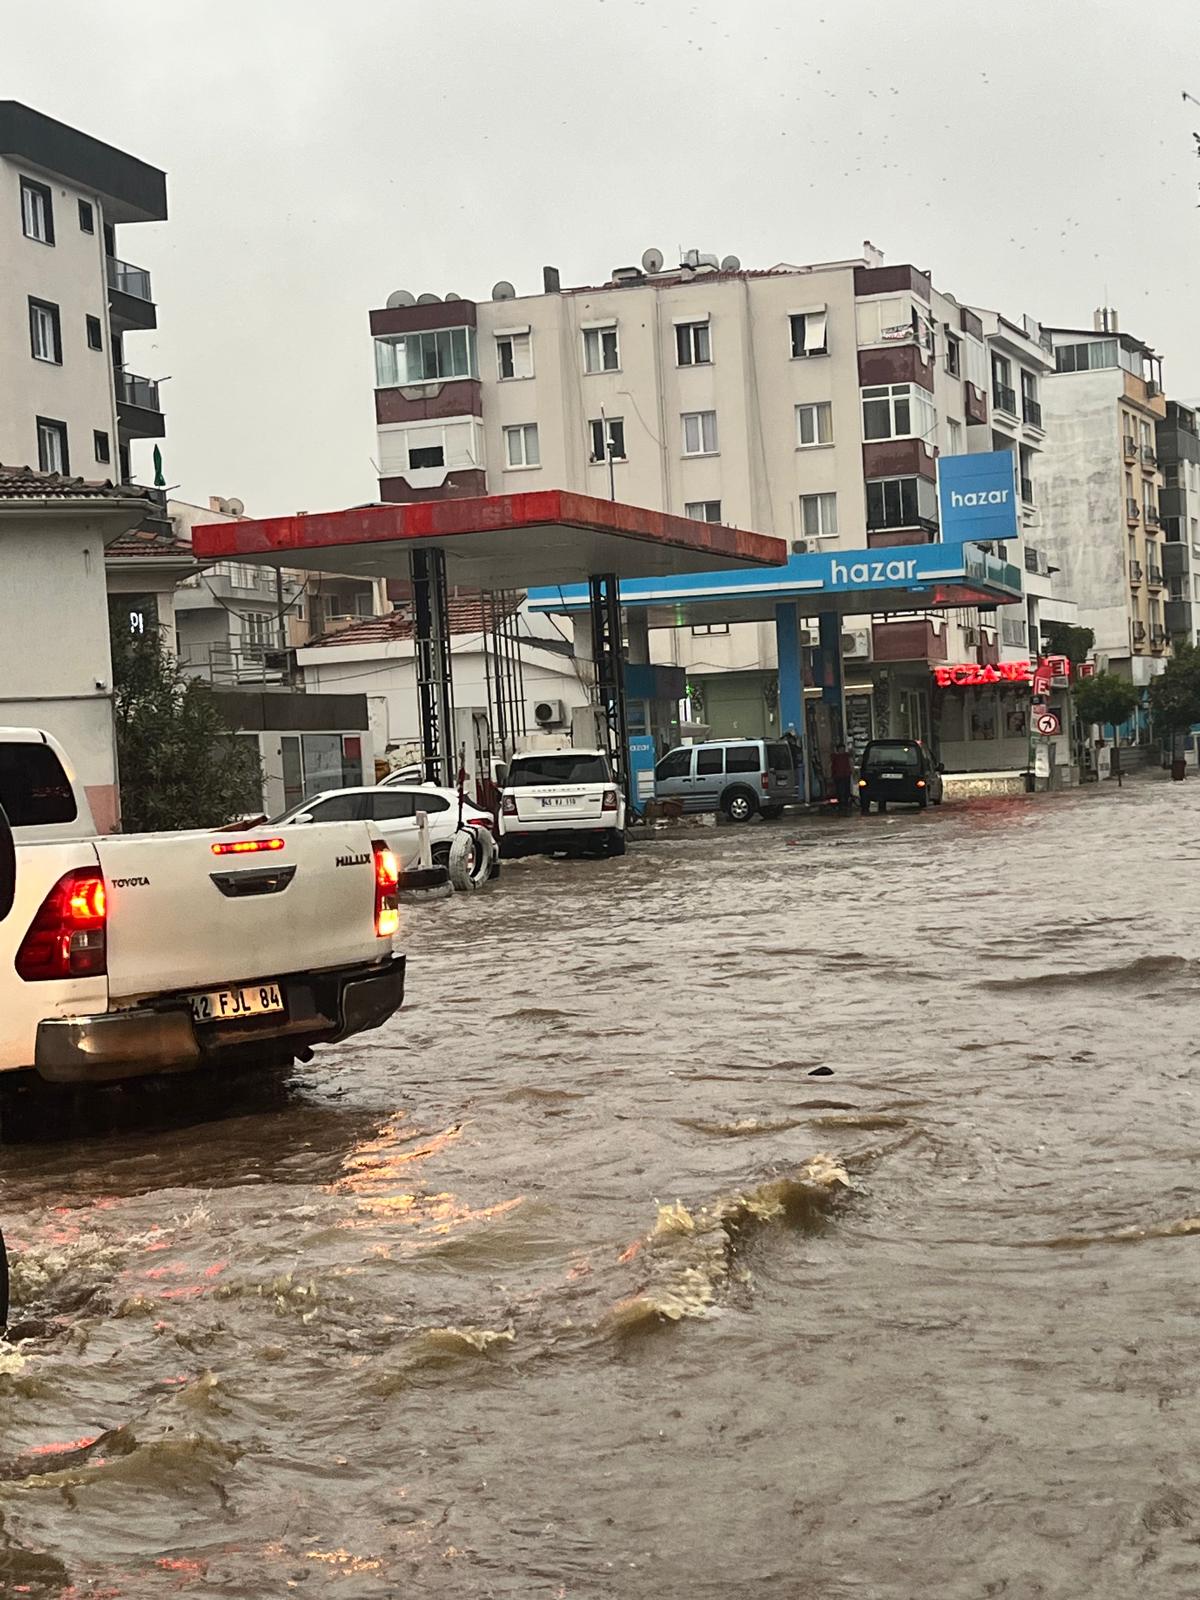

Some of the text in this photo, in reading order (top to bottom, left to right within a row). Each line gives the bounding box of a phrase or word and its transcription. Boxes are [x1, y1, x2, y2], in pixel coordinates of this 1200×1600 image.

[952, 489, 1009, 507] hazar
[831, 559, 917, 585] hazar
[935, 660, 1034, 688] ECZANE
[336, 853, 371, 867] HILUX
[111, 876, 151, 888] TOYOTA
[259, 986, 280, 1009] 84
